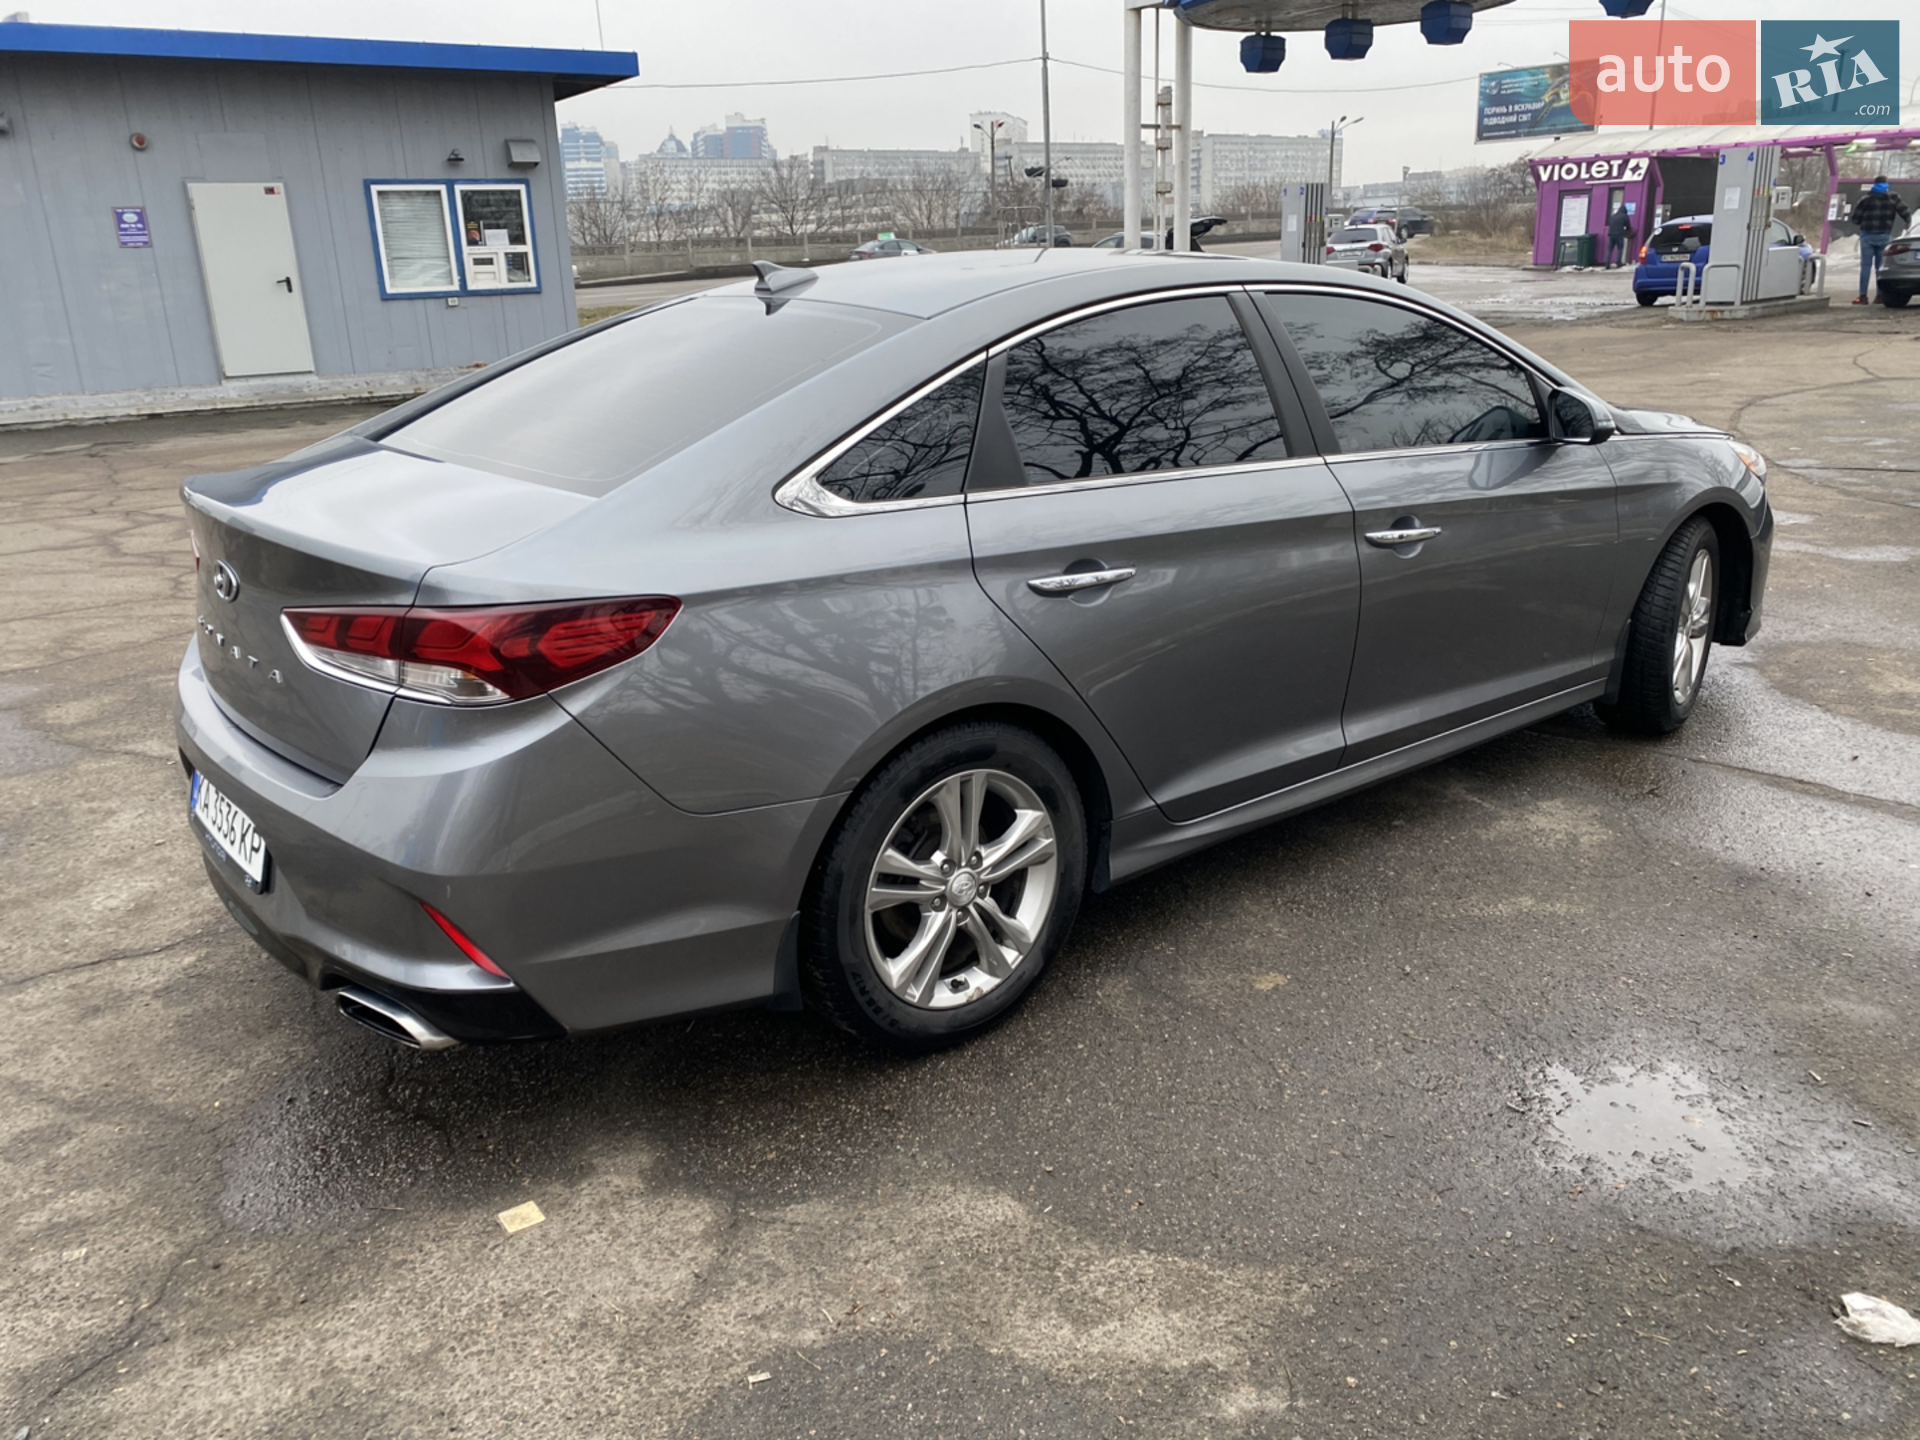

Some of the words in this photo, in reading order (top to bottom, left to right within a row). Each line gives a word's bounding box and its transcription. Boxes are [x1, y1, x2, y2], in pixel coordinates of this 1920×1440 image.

[1718, 154, 1727, 165] 3
[1747, 151, 1755, 162] 4
[212, 788, 239, 846] 3536
[238, 816, 262, 864] KP
